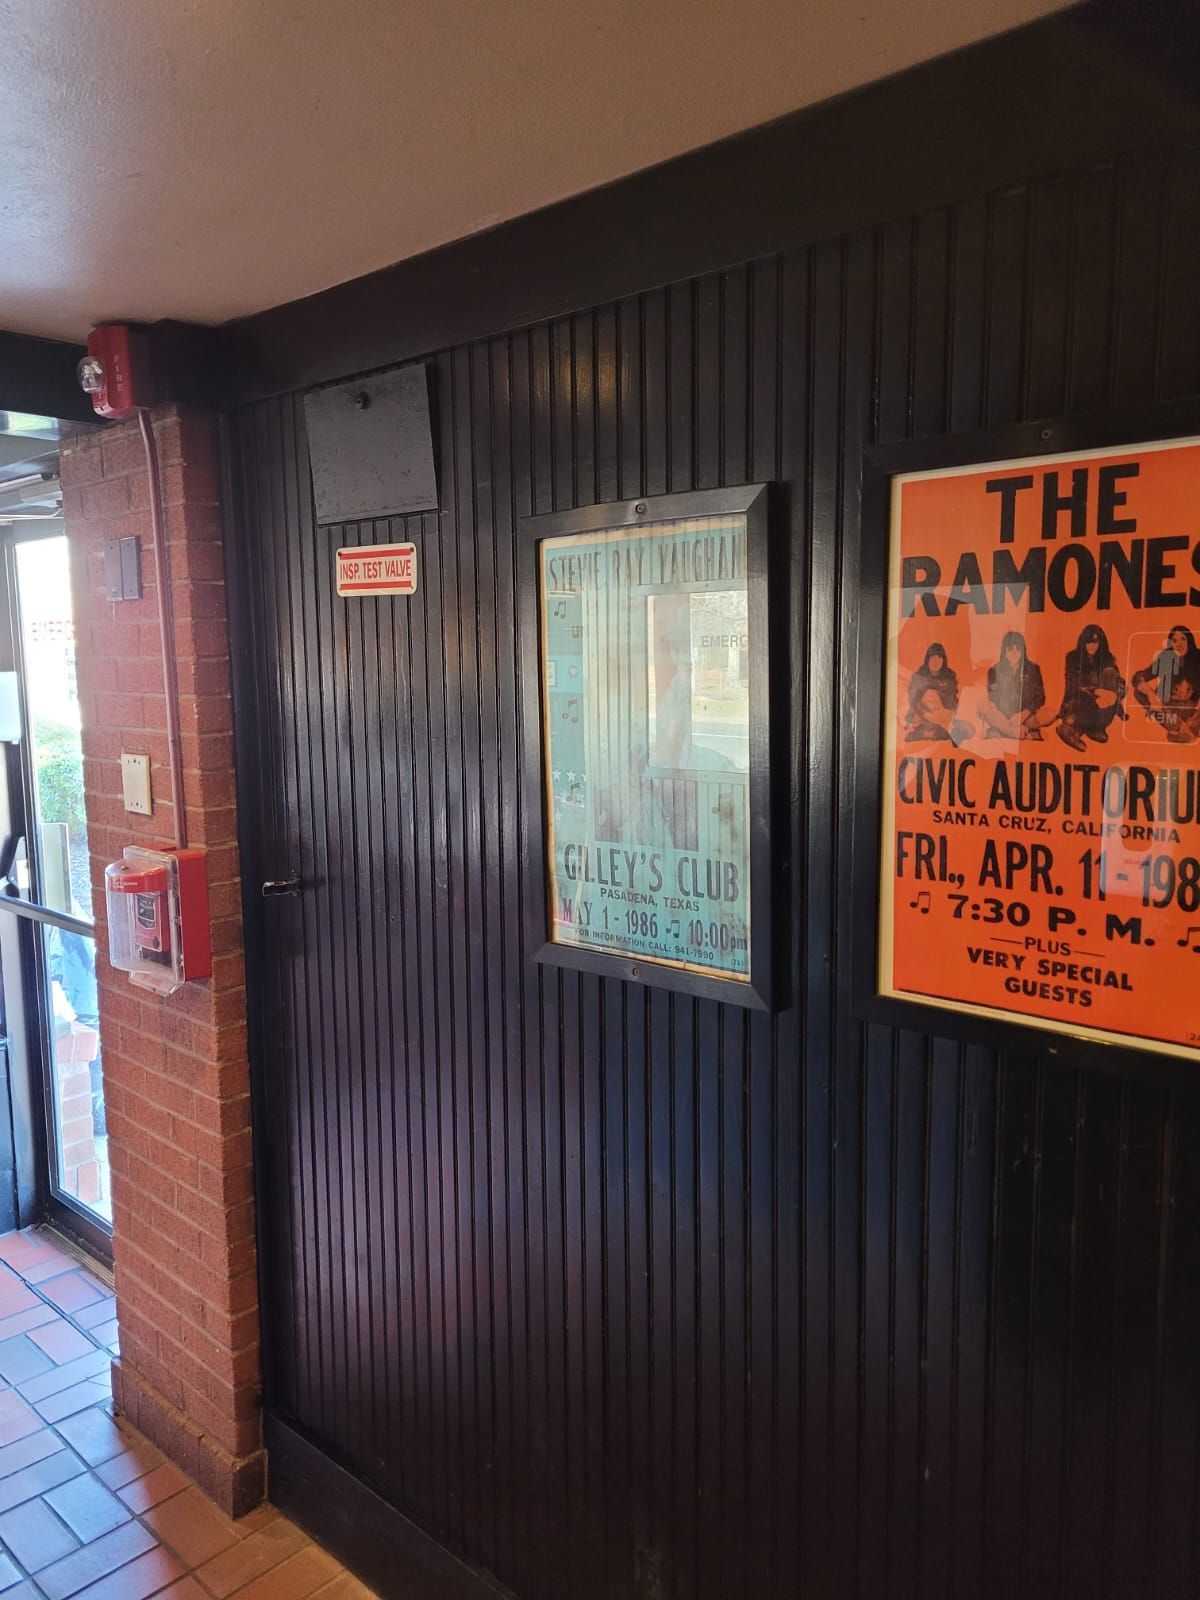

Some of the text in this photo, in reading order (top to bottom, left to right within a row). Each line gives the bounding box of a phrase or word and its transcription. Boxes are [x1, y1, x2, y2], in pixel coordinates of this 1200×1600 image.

[114, 354, 124, 391] FIRE
[986, 462, 1140, 543] THE
[340, 560, 411, 580] INSP. TEST VALVE
[550, 534, 745, 592] STEVIE RAY VAUGHAN
[901, 535, 1200, 618] RAMONE
[898, 757, 1200, 825] CIVIC AUDITORIU
[932, 810, 1180, 843] SANTA CRUZ, CALIFORNIA
[564, 843, 739, 902] GILLEY'S CLUB
[896, 831, 965, 889] FRI.,
[978, 839, 1064, 895] APR.
[562, 898, 593, 926] MAY
[602, 905, 609, 930] 1
[625, 909, 658, 938] 1986
[600, 887, 700, 912] PASADENA, TEXAS
[947, 893, 1155, 946] 7:30 P. M.
[592, 930, 645, 949] INFORMATION
[648, 941, 671, 953] CALL:
[1024, 936, 1071, 957] PLUS
[967, 947, 1133, 991] VERY SPECIAL
[1004, 976, 1093, 1007] GUESTS
